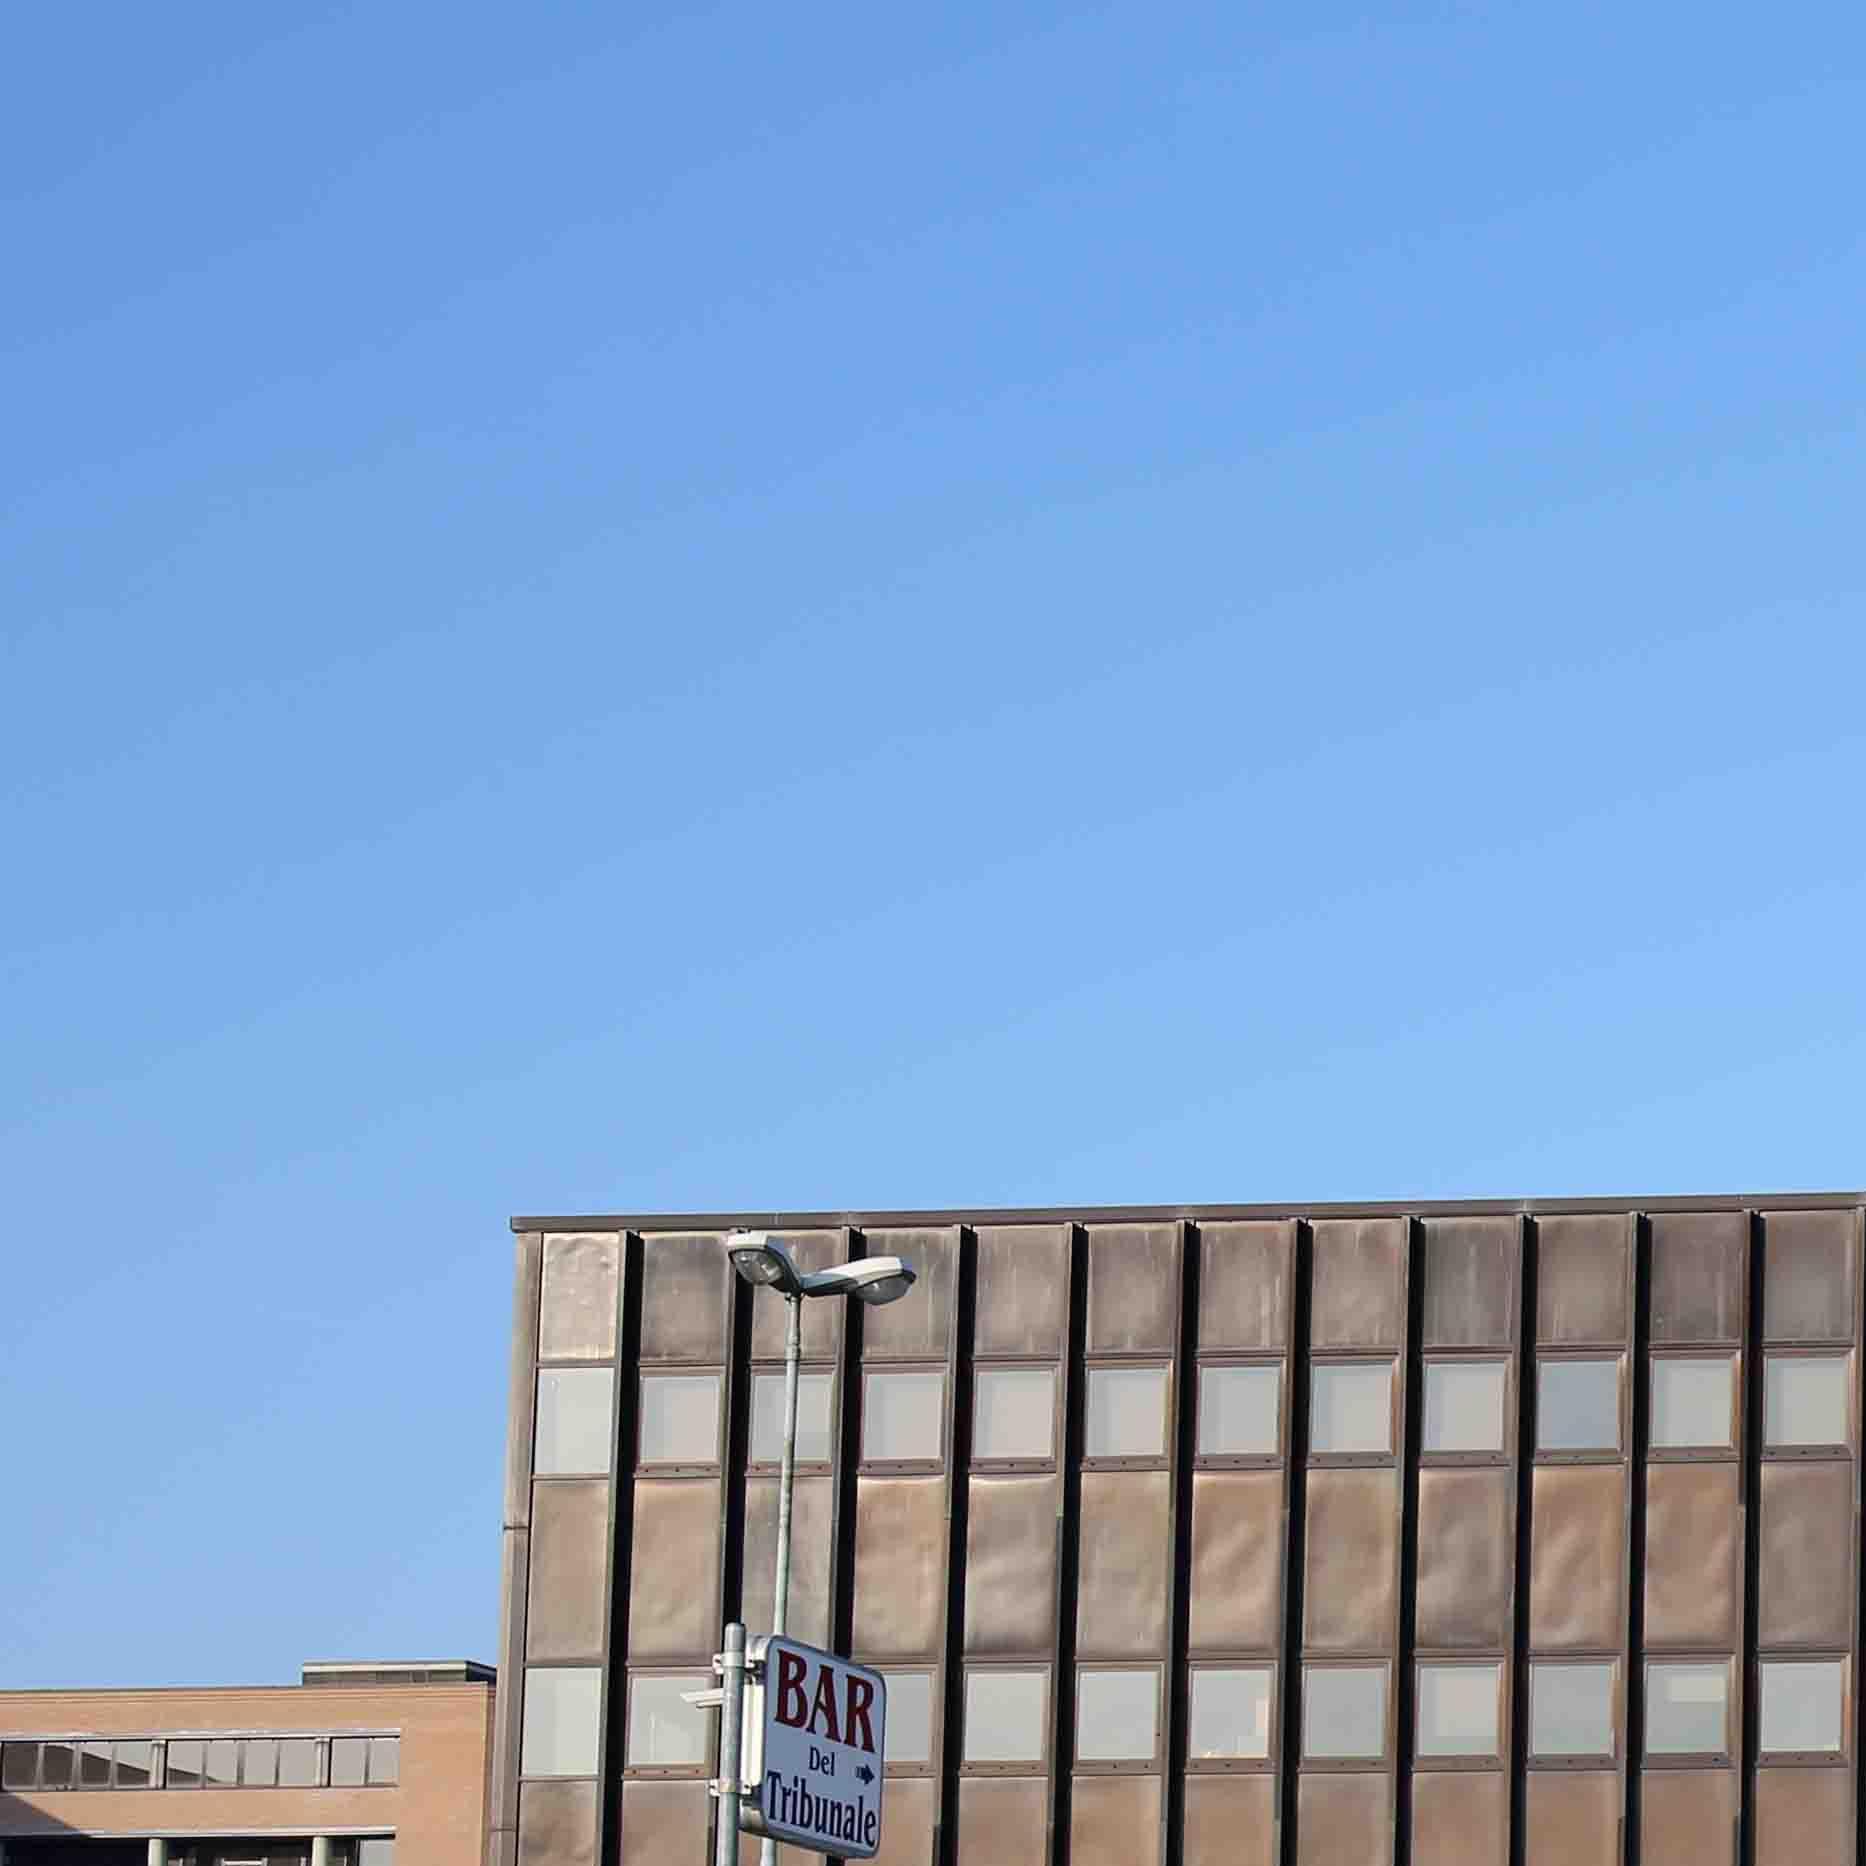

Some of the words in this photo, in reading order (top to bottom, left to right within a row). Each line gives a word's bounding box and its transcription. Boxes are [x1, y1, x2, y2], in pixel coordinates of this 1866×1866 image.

[775, 1648, 875, 1753] BAR
[809, 1746, 835, 1776] Del
[767, 1770, 877, 1848] Tribunale
